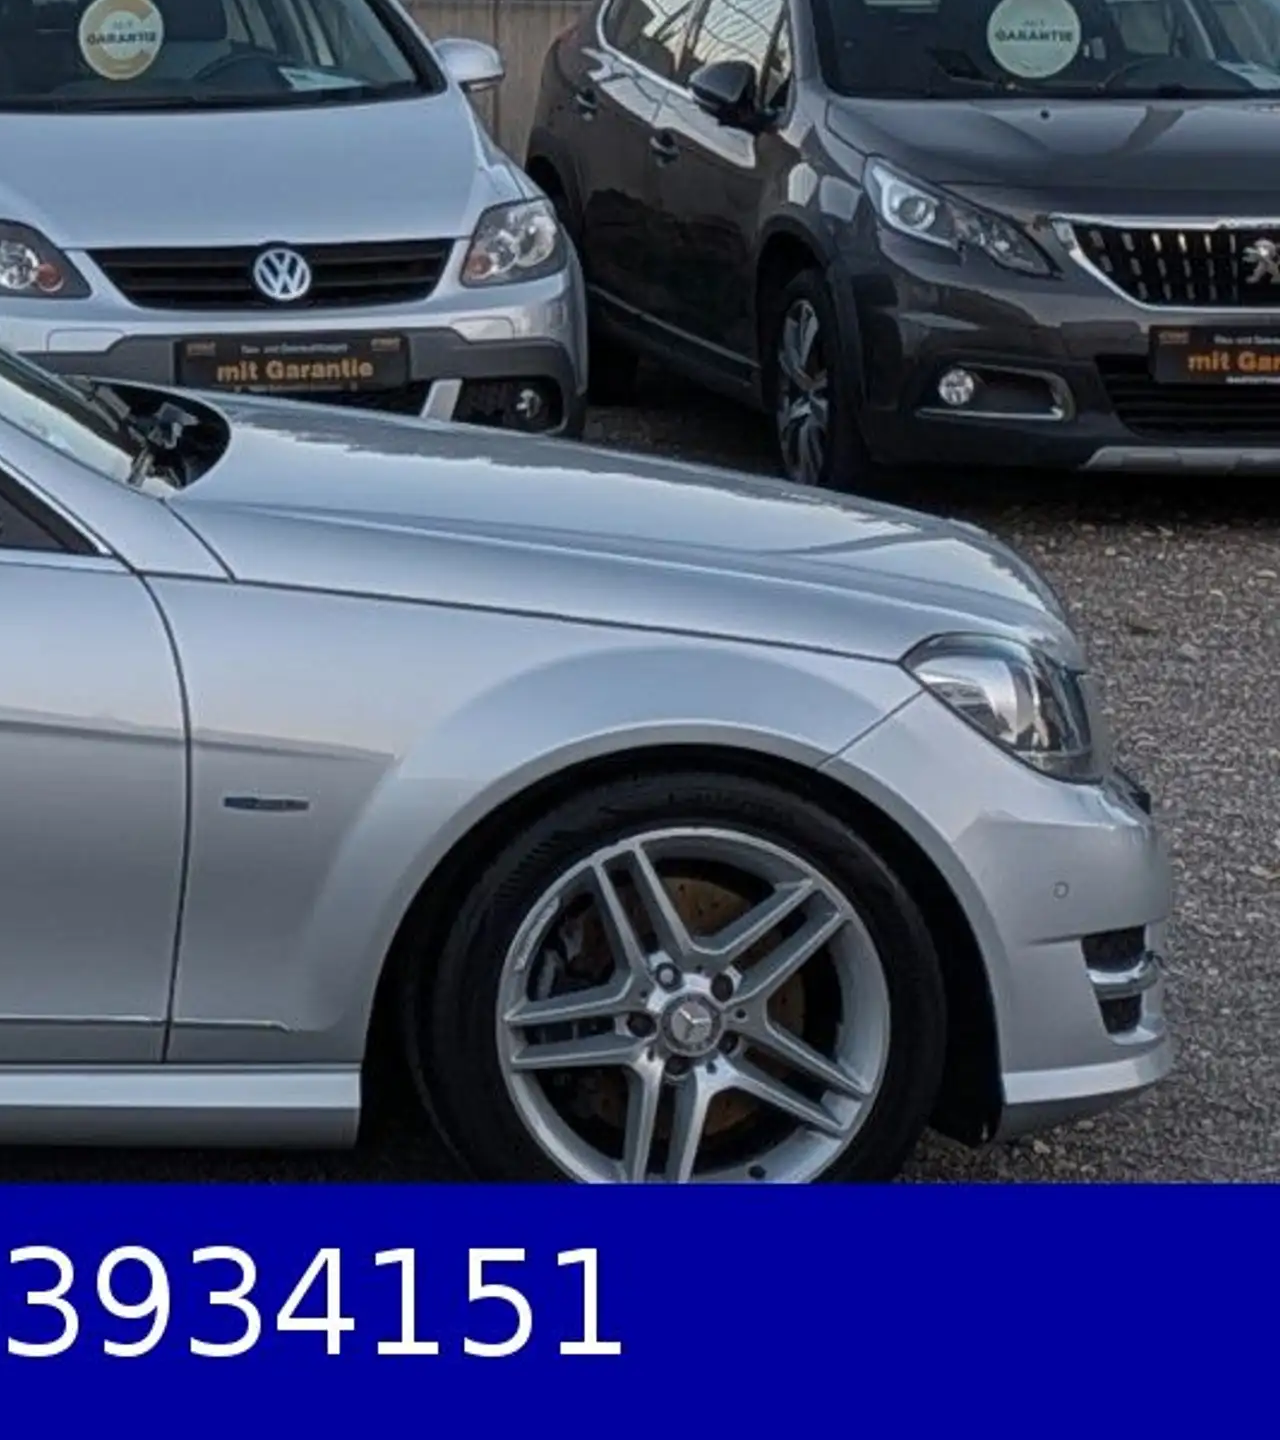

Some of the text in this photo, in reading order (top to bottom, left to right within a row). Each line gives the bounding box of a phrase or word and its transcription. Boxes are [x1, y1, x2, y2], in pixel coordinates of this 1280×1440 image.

[216, 358, 374, 383] mit Garantie
[1188, 350, 1230, 372] mit
